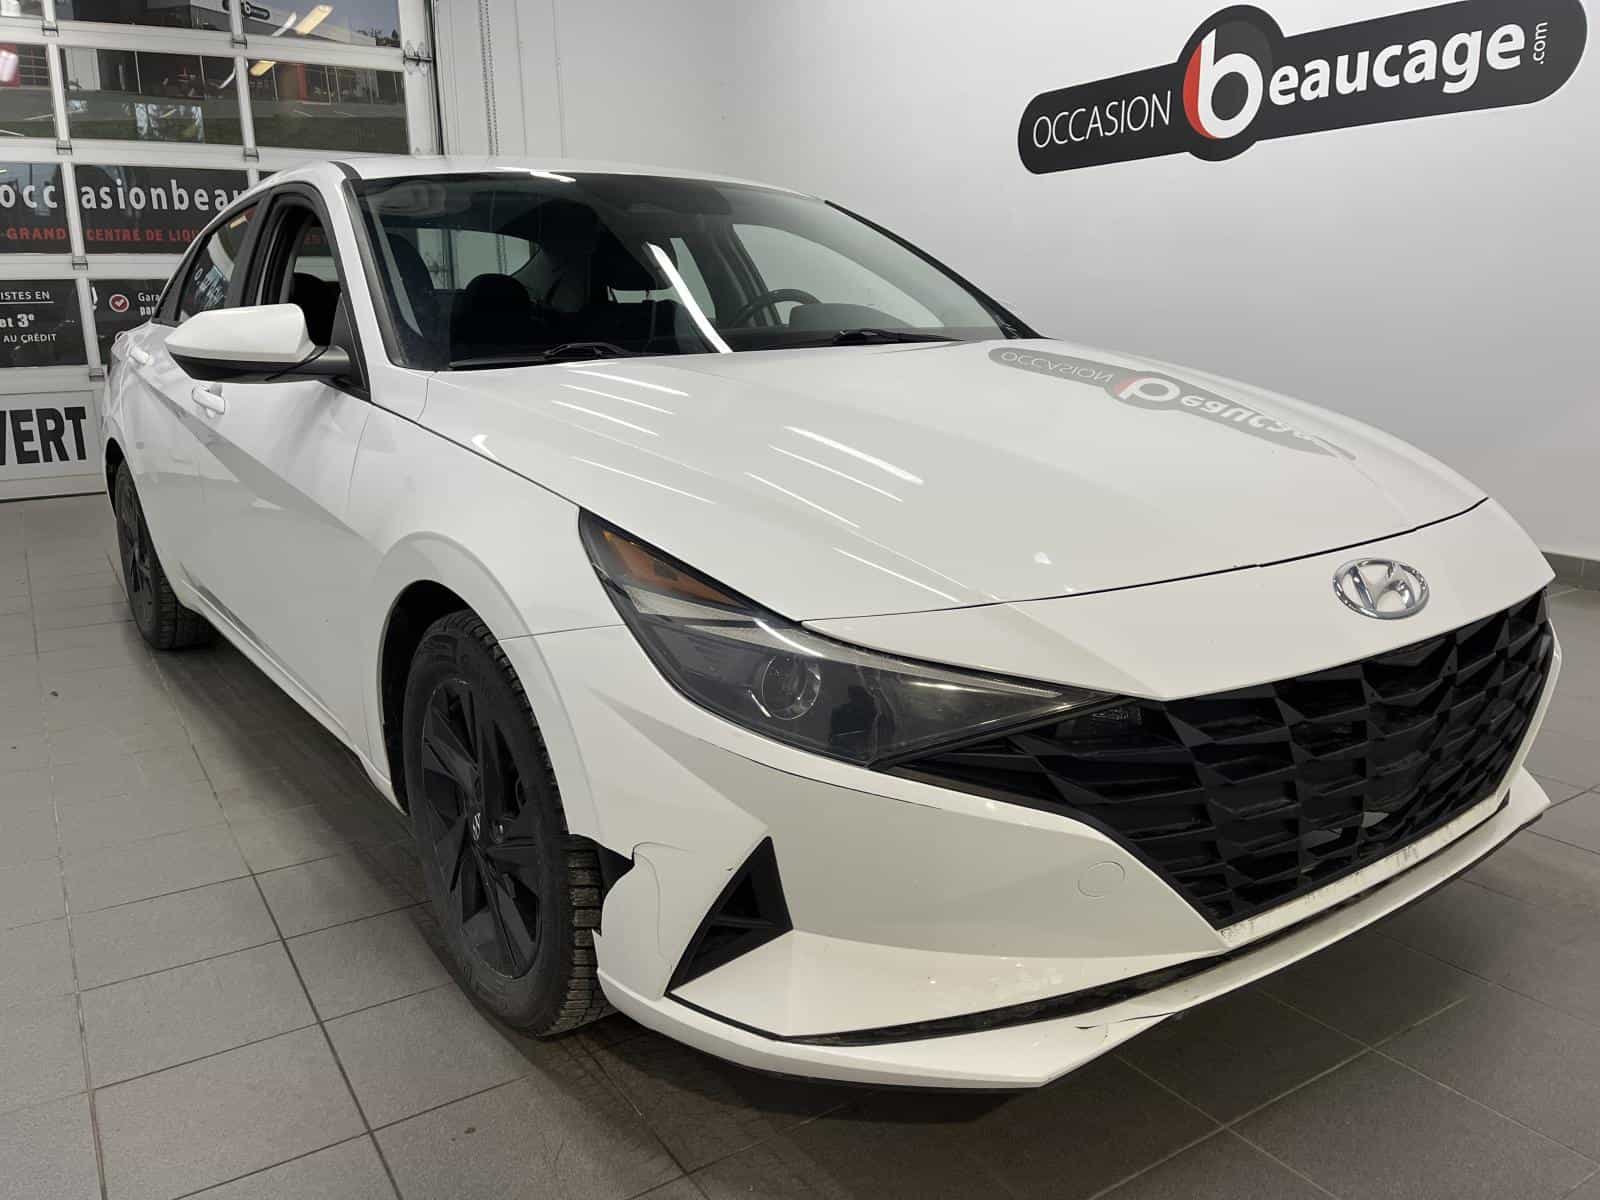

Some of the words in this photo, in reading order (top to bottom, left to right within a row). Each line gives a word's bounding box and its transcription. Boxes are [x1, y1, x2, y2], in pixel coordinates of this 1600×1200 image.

[1533, 20, 1549, 65] .com
[1032, 90, 1172, 149] OCCASION
[1183, 22, 1525, 140] beaucage
[6, 227, 66, 242] GRAND
[145, 229, 163, 242] DE
[35, 290, 51, 301] EN
[3, 334, 18, 344] AU
[20, 332, 57, 344] CRÉDIT
